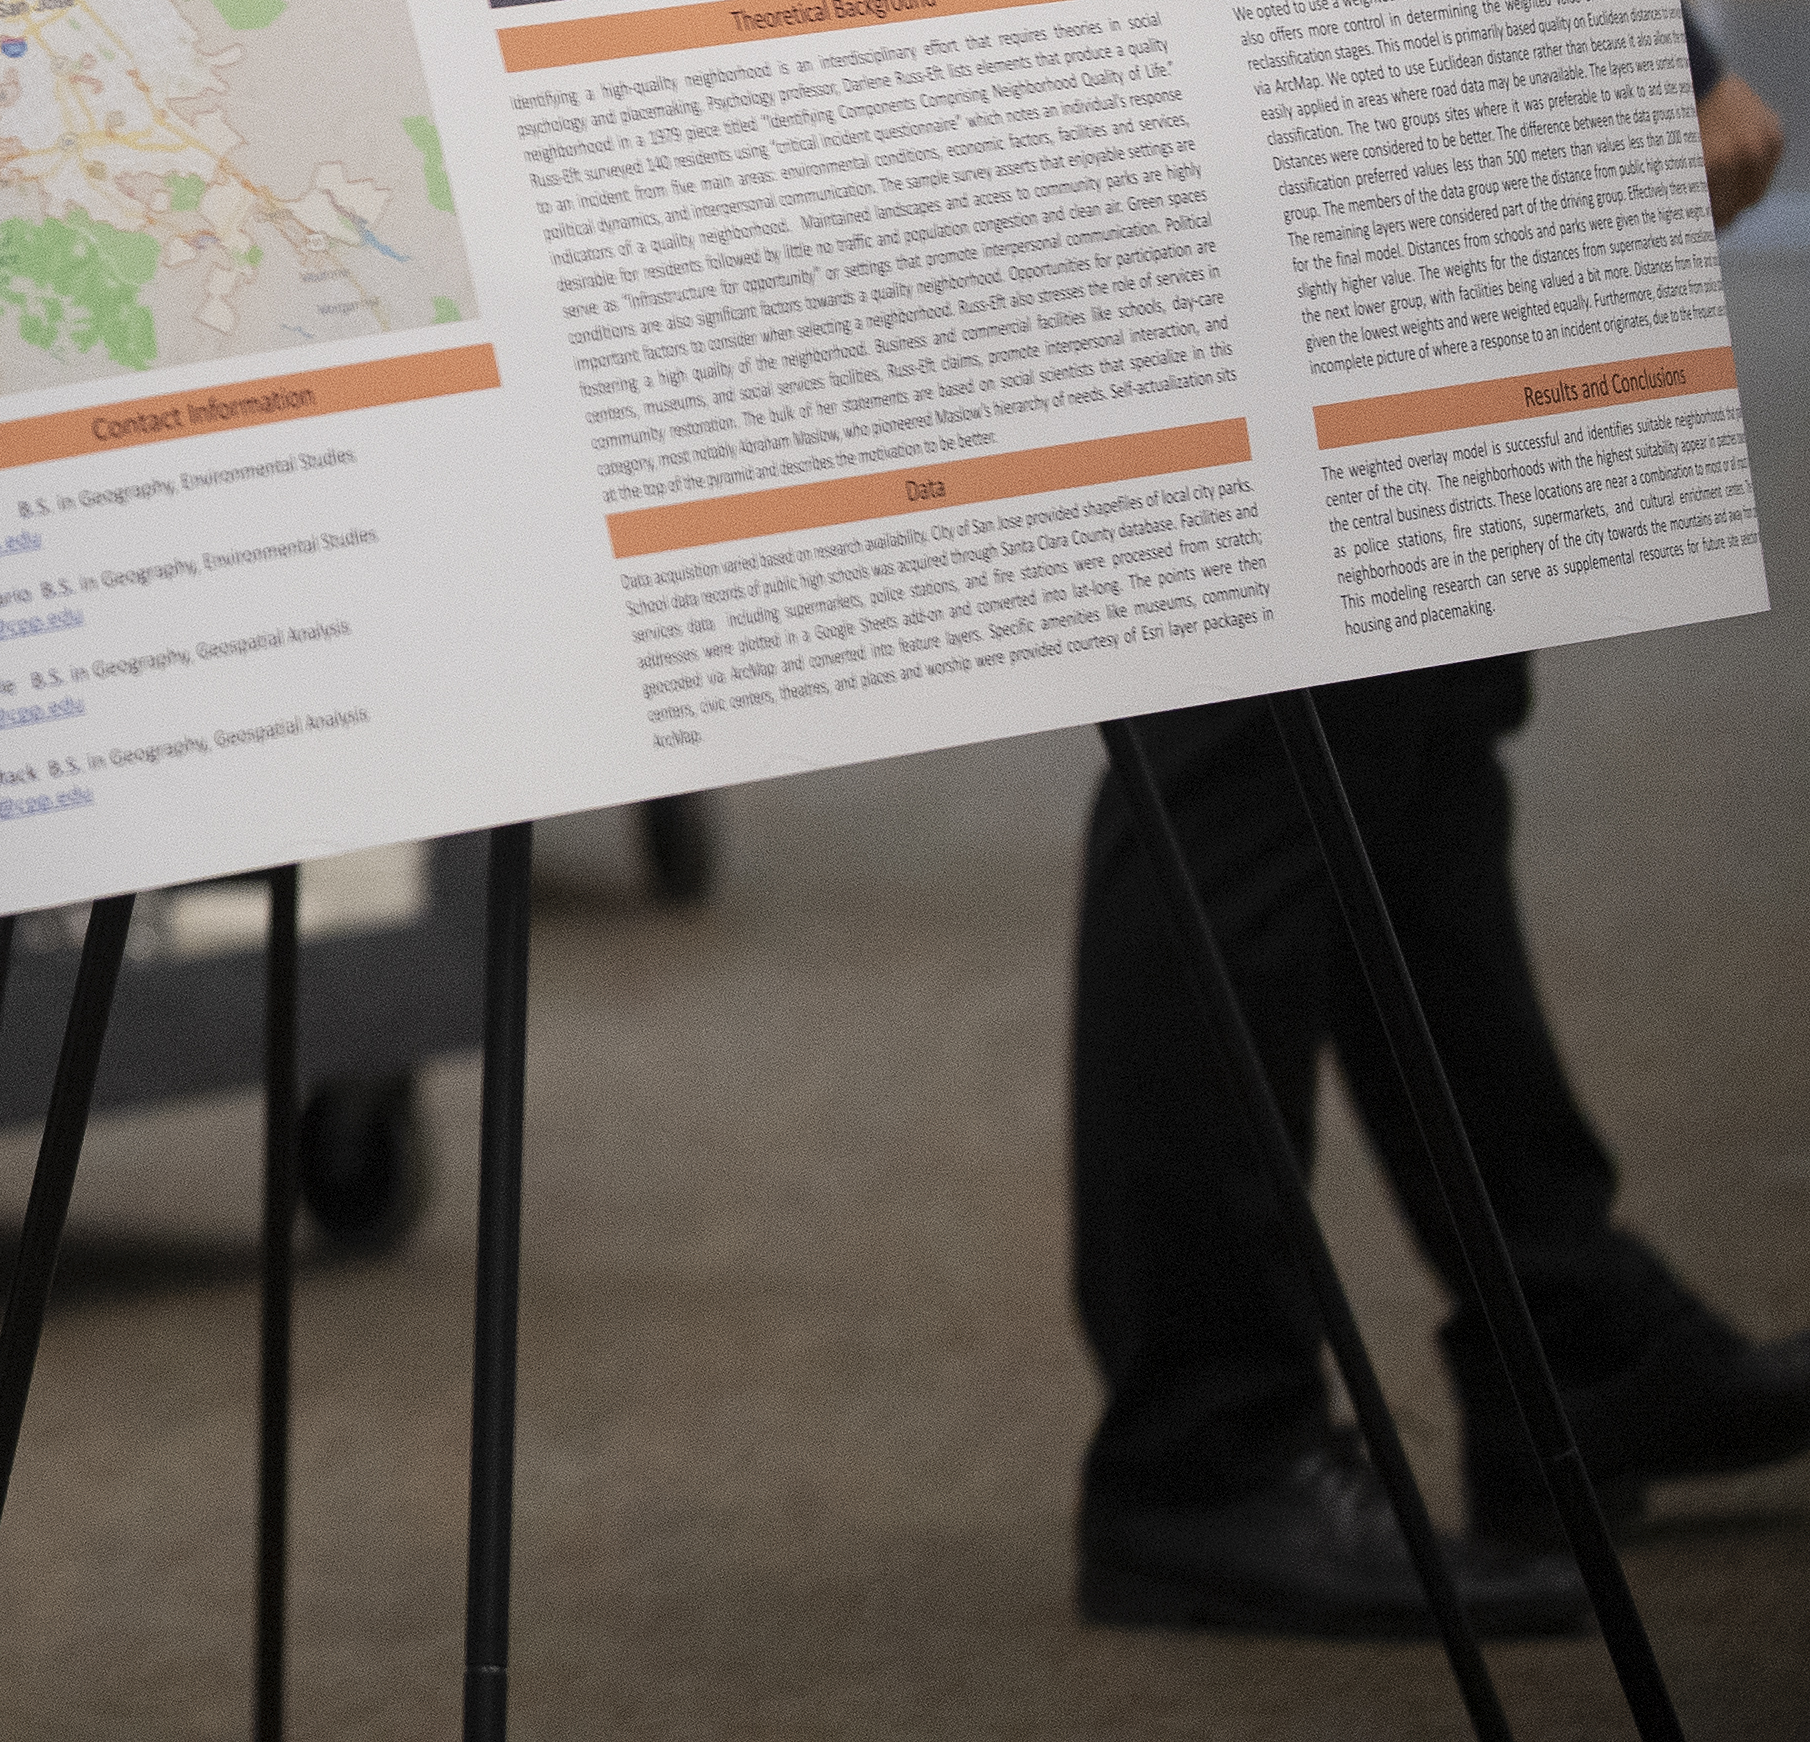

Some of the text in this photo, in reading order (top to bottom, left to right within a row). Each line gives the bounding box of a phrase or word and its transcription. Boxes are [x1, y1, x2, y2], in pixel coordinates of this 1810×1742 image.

[730, 0, 831, 31] Theoretical
[1523, 368, 1687, 408] Results and Conclusions
[91, 389, 316, 442] Contact Information
[905, 479, 946, 502] Data
[1343, 600, 1495, 635] housing and placemaking.
